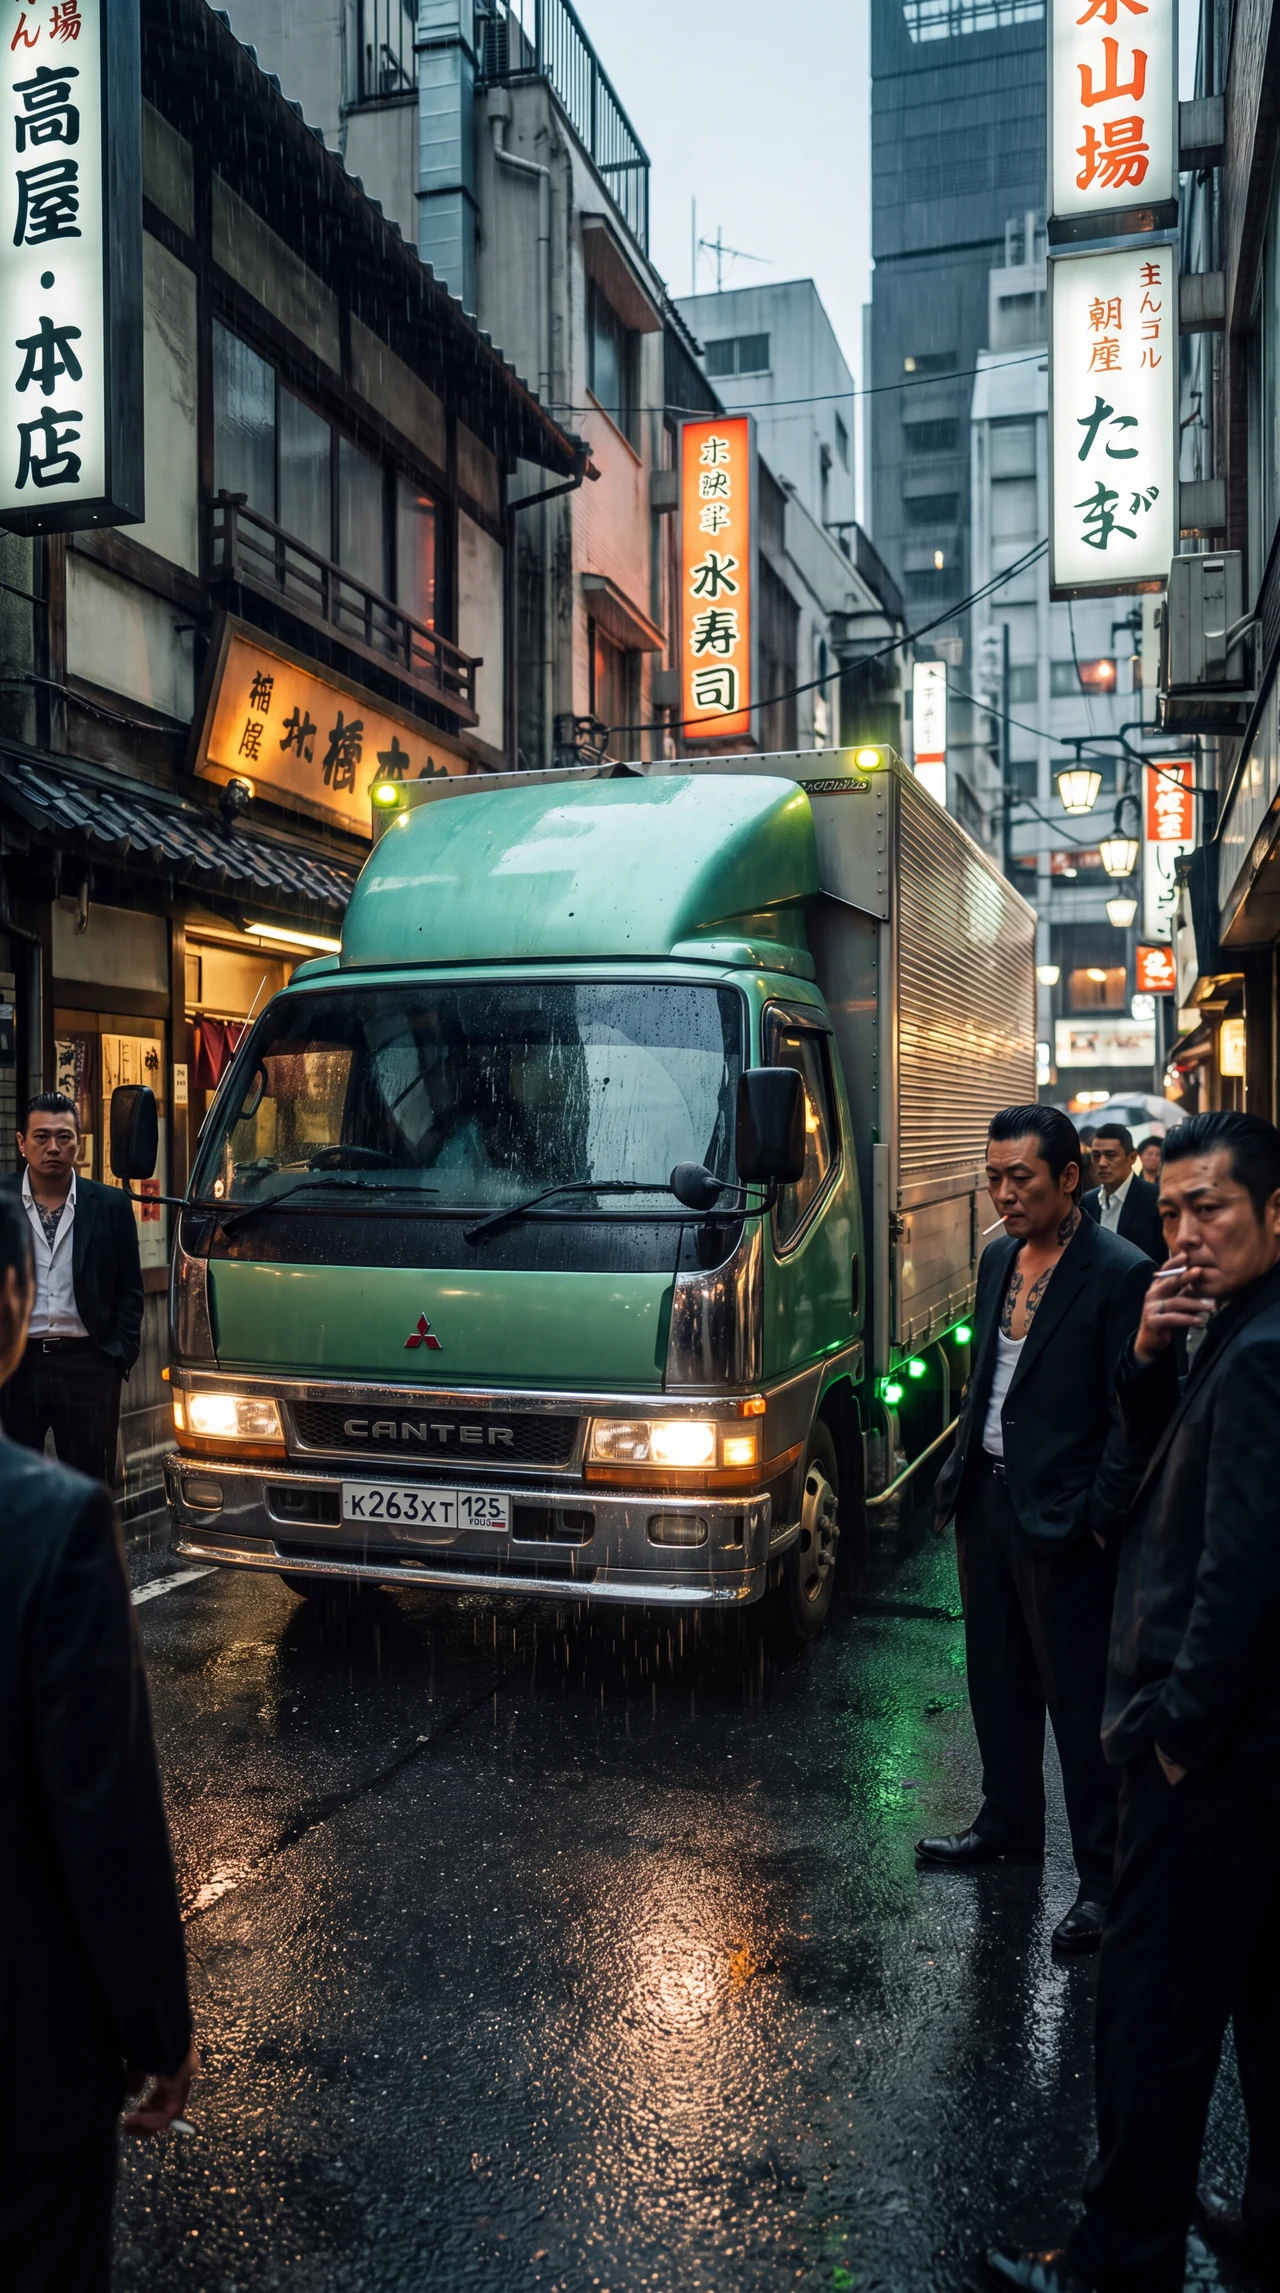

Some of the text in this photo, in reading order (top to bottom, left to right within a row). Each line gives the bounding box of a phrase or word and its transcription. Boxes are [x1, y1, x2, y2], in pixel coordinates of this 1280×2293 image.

[11, 0, 41, 51] ん
[693, 553, 737, 712] 水寿司
[343, 1419, 515, 1447] CANTER
[461, 1496, 501, 1518] 125
